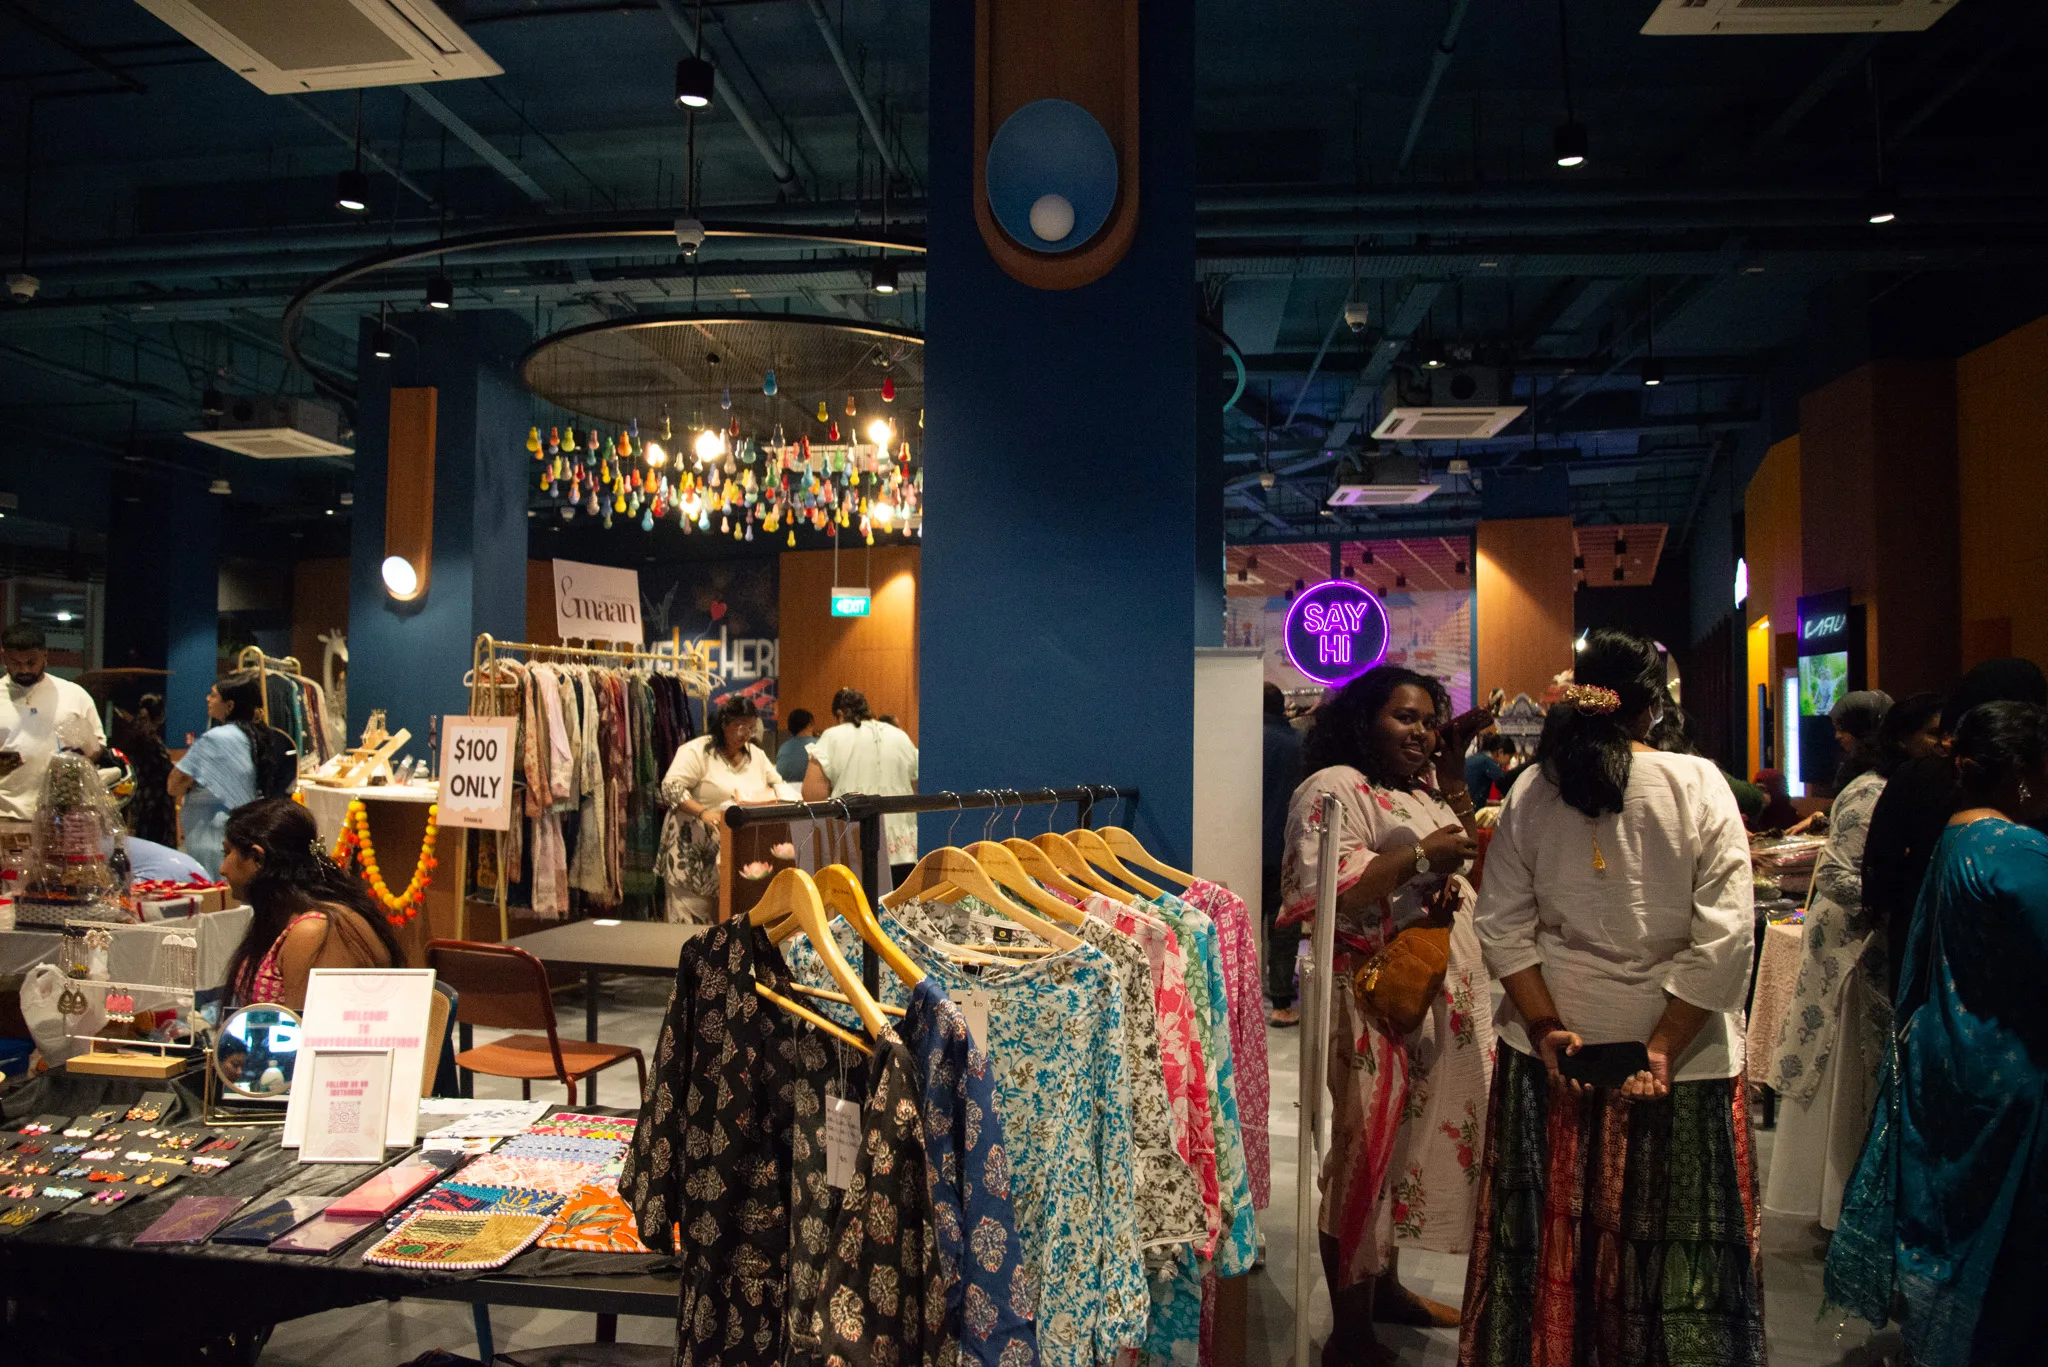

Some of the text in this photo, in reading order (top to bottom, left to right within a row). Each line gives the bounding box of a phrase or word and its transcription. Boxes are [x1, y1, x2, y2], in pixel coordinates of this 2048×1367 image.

[561, 575, 637, 624] Emaan
[842, 599, 866, 614] EXIT
[1303, 602, 1368, 633] SAY
[721, 624, 779, 679] HER
[1319, 634, 1351, 663] HI
[454, 734, 498, 764] $100
[450, 774, 502, 799] ONLY
